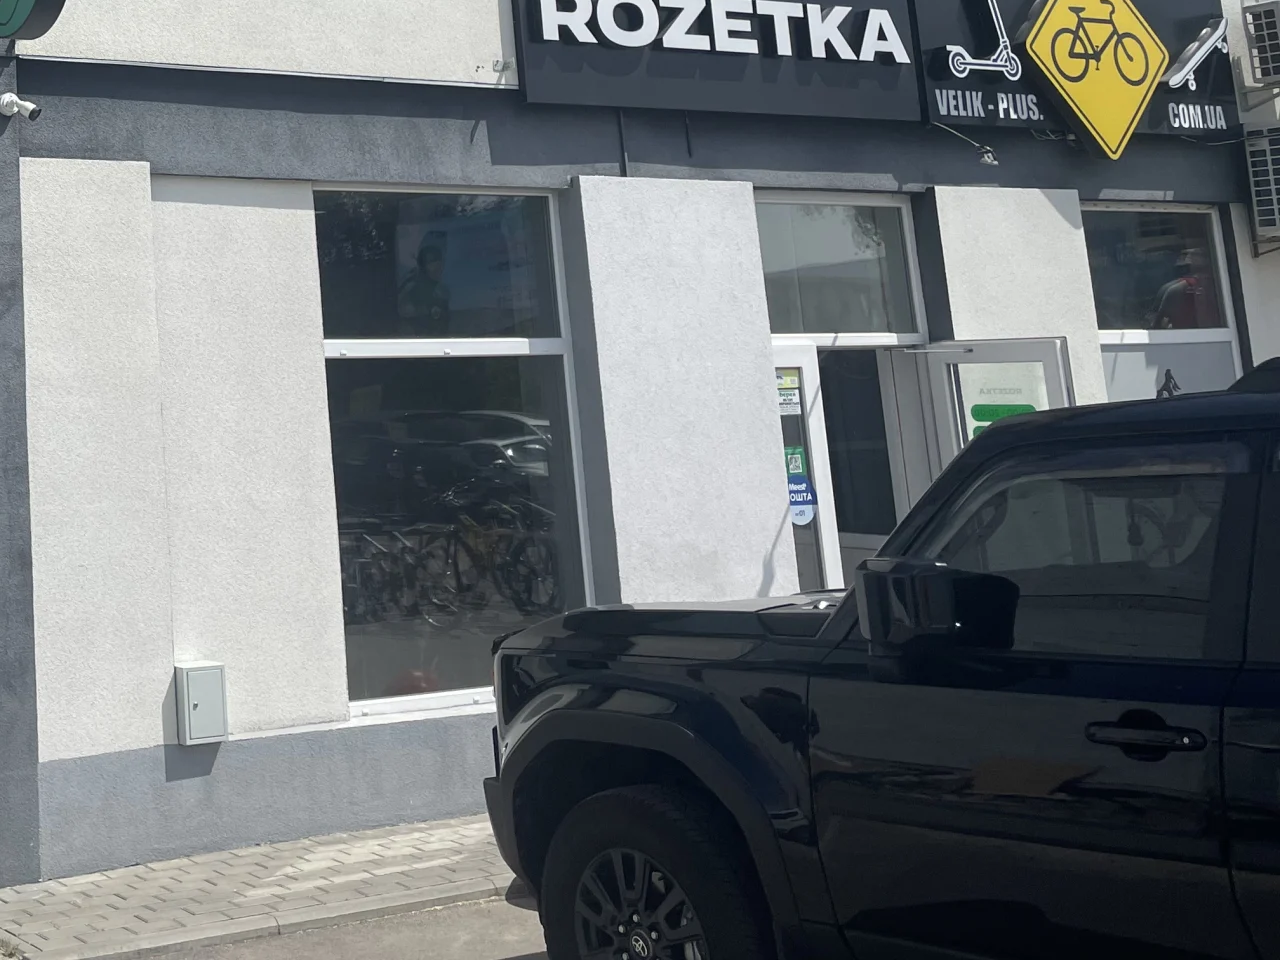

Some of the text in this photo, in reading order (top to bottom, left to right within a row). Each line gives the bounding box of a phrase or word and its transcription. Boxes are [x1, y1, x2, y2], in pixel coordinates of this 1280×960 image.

[935, 89, 986, 118] VELIK
[1168, 102, 1227, 130] COM.UA
[790, 493, 812, 502] ОШТА
